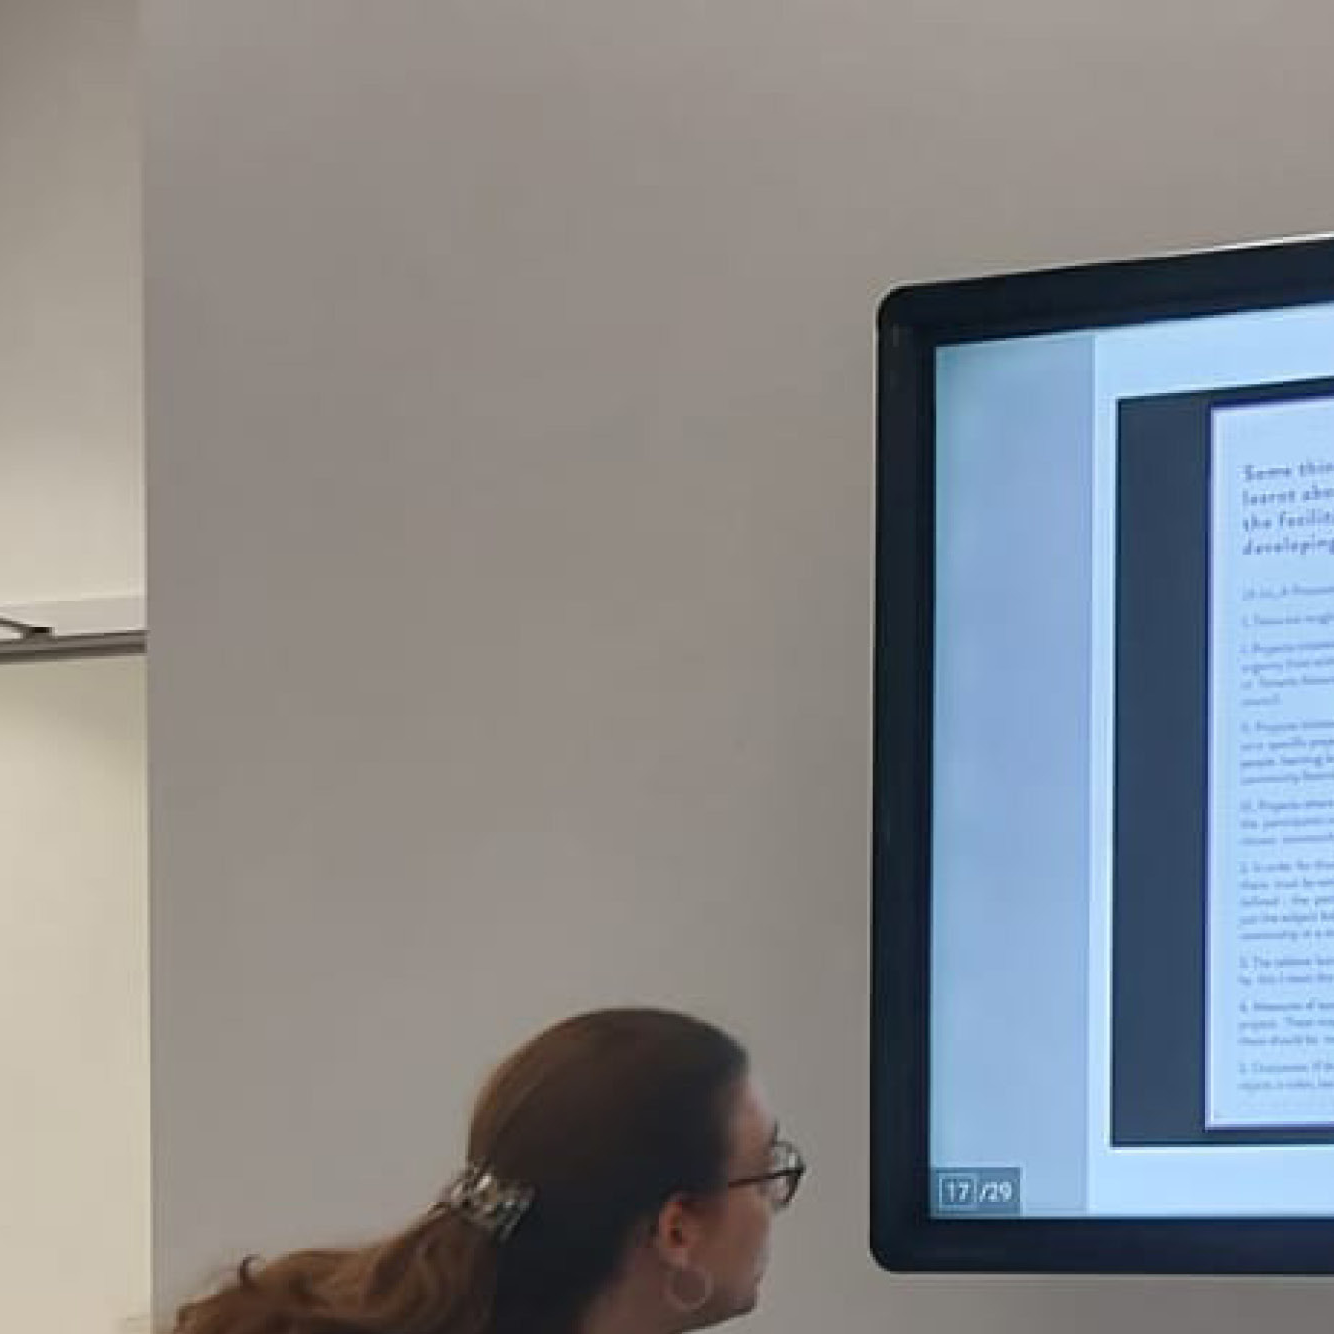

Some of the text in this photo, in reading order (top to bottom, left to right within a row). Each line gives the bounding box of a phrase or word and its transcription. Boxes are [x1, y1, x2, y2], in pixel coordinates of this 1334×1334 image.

[1244, 462, 1291, 481] Some
[1242, 488, 1295, 507] learnt
[1242, 512, 1273, 532] the
[944, 1180, 970, 1204] 17
